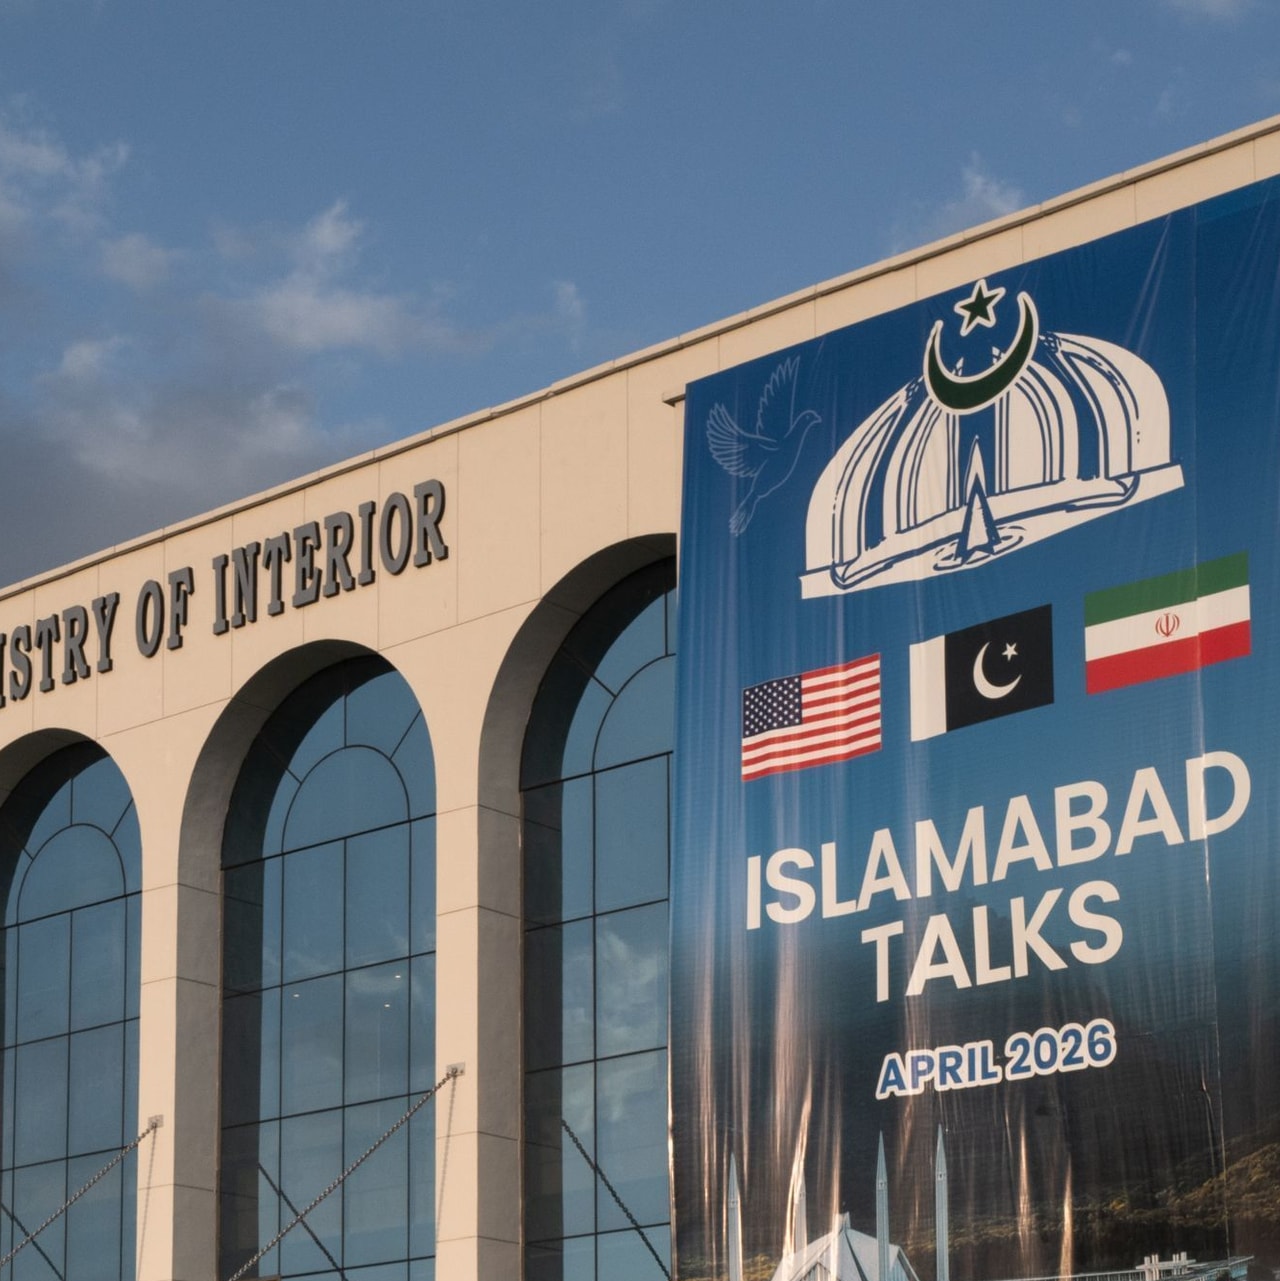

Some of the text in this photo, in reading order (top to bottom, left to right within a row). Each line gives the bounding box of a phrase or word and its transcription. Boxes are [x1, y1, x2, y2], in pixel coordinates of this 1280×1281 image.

[136, 566, 194, 658] OF
[212, 479, 448, 636] INTERIOR
[746, 750, 1251, 930] ISLAMABAD
[861, 879, 1123, 1002] TALKS
[875, 1017, 1117, 1099] APRIL 2026
